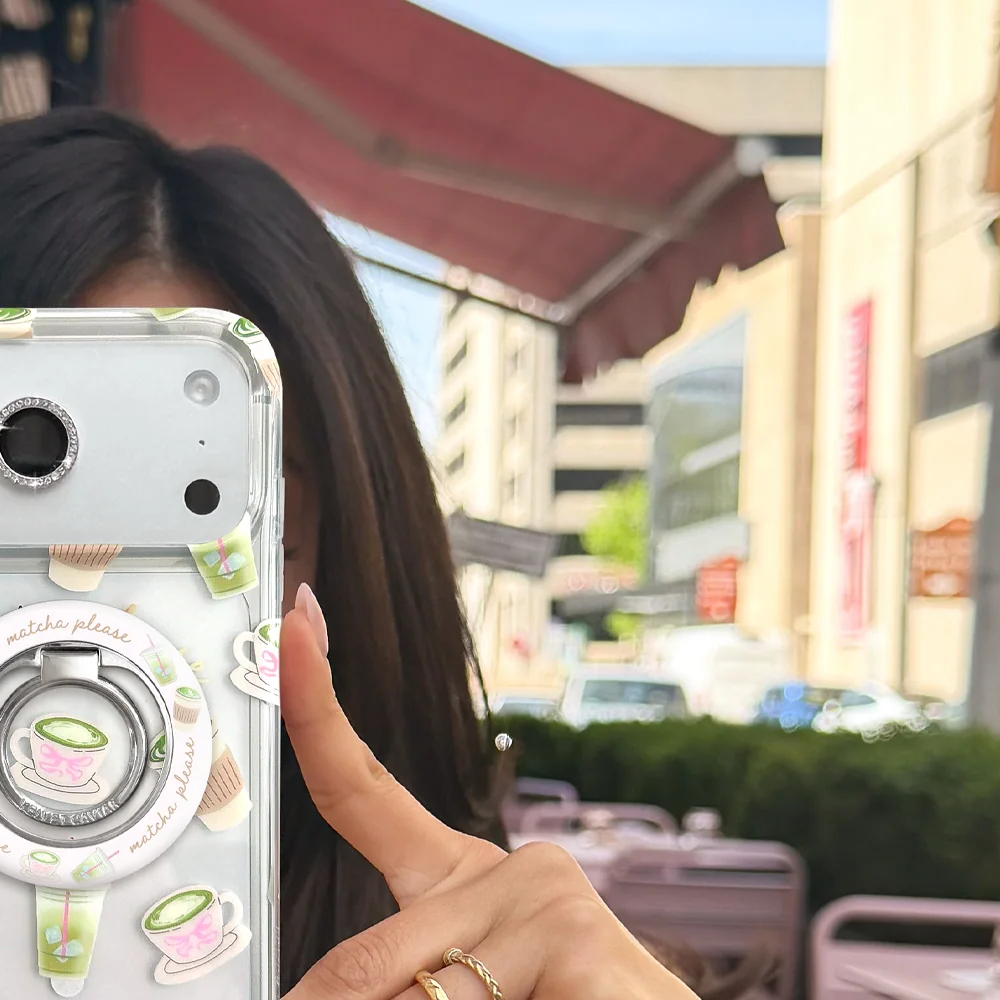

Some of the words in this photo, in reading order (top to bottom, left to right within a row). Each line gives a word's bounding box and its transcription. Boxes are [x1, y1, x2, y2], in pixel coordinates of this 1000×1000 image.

[6, 614, 69, 646] matcha
[72, 613, 132, 643] please
[129, 802, 178, 853] matcha
[176, 737, 195, 800] please
